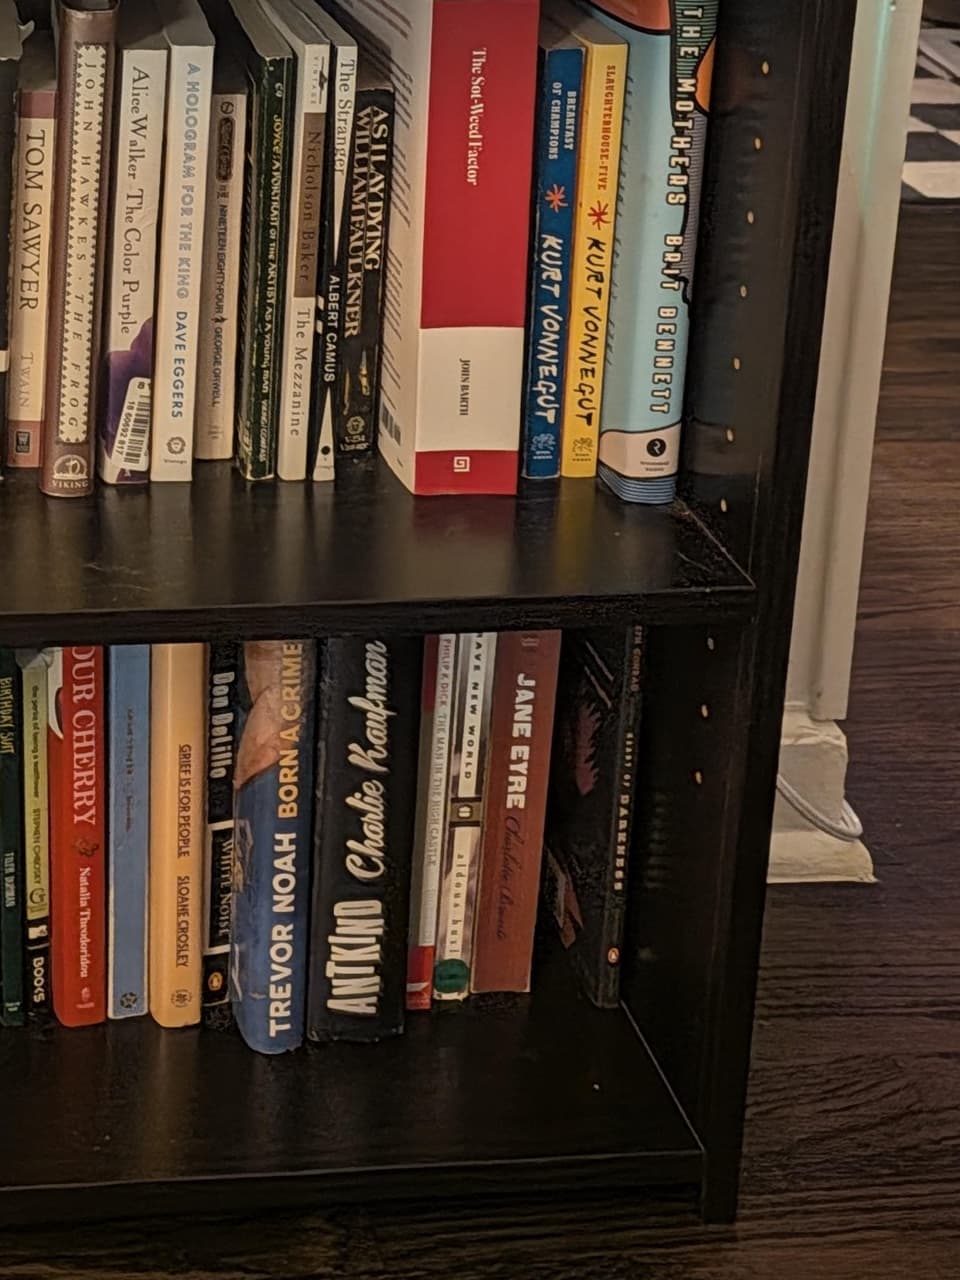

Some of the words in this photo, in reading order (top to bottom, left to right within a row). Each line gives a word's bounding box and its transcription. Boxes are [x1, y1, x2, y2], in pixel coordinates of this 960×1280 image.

[472, 48, 487, 73] The
[679, 7, 703, 58] THE
[129, 66, 152, 116] Alice
[469, 75, 485, 137] Sot-Weed
[127, 118, 148, 179] Walker
[597, 64, 617, 191] SLAUGHTERHOUSE-FIVE
[665, 76, 699, 208] MOTHERS
[24, 130, 46, 191] TOM
[466, 141, 482, 186] Factor
[123, 189, 146, 223] The
[20, 202, 43, 310] SAWYER
[121, 228, 142, 274] Color
[584, 235, 608, 299] KURT
[661, 233, 686, 294] BRIT
[117, 279, 140, 334] Purple
[174, 310, 188, 351] DAVE
[170, 357, 186, 419] EGGERS
[576, 305, 602, 427] VONNEGUT
[648, 306, 679, 415] BENNETT
[280, 644, 303, 722] CRIME
[345, 640, 399, 773] Kaufman
[512, 672, 537, 738] JANE
[279, 725, 299, 740] A
[72, 708, 97, 825] CHERRY
[277, 749, 300, 818] BORN
[505, 745, 532, 810] EYRE
[344, 780, 386, 883] Charlie
[271, 831, 297, 913] NOAH
[267, 924, 295, 1038] TREVOR
[325, 900, 385, 1015] ANTKIND
